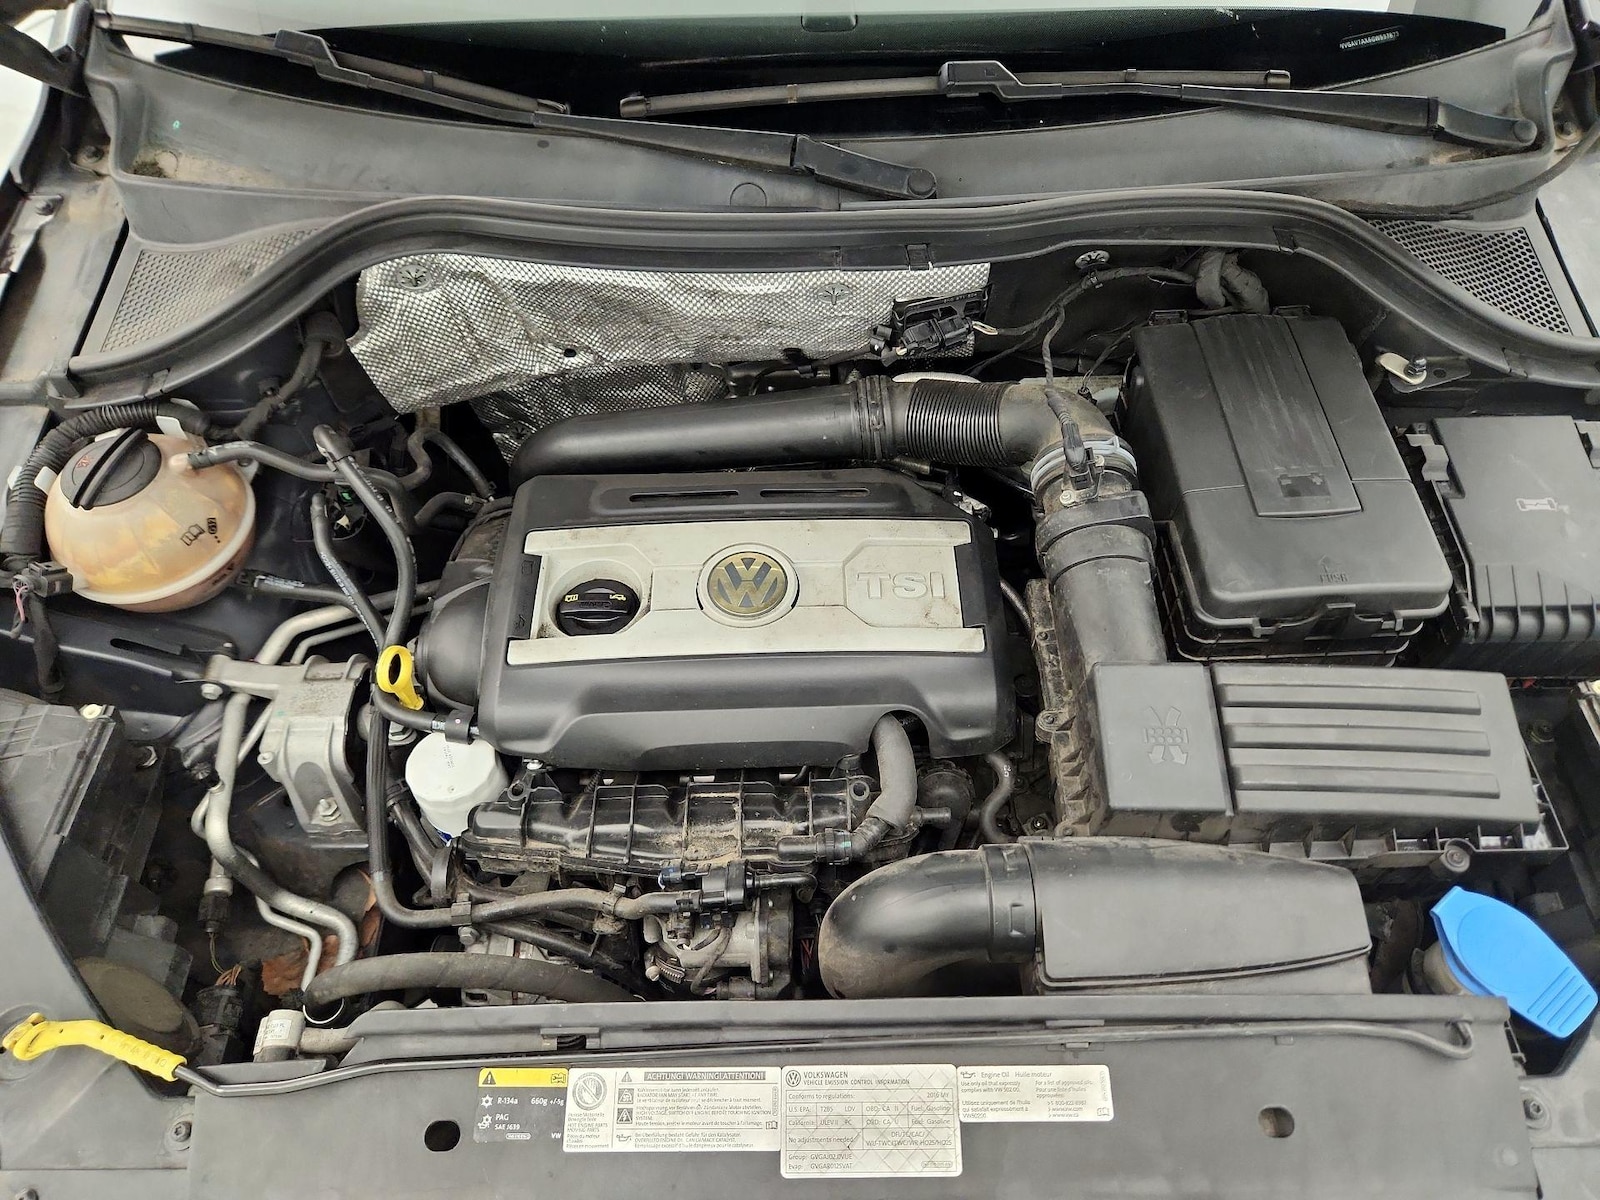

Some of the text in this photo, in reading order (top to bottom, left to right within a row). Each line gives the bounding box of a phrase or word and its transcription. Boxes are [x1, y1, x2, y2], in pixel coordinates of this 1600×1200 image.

[856, 570, 946, 600] TSI
[647, 1072, 684, 1080] ACHTUNG!
[497, 1097, 518, 1106] R-134a
[531, 1097, 547, 1106] 660g
